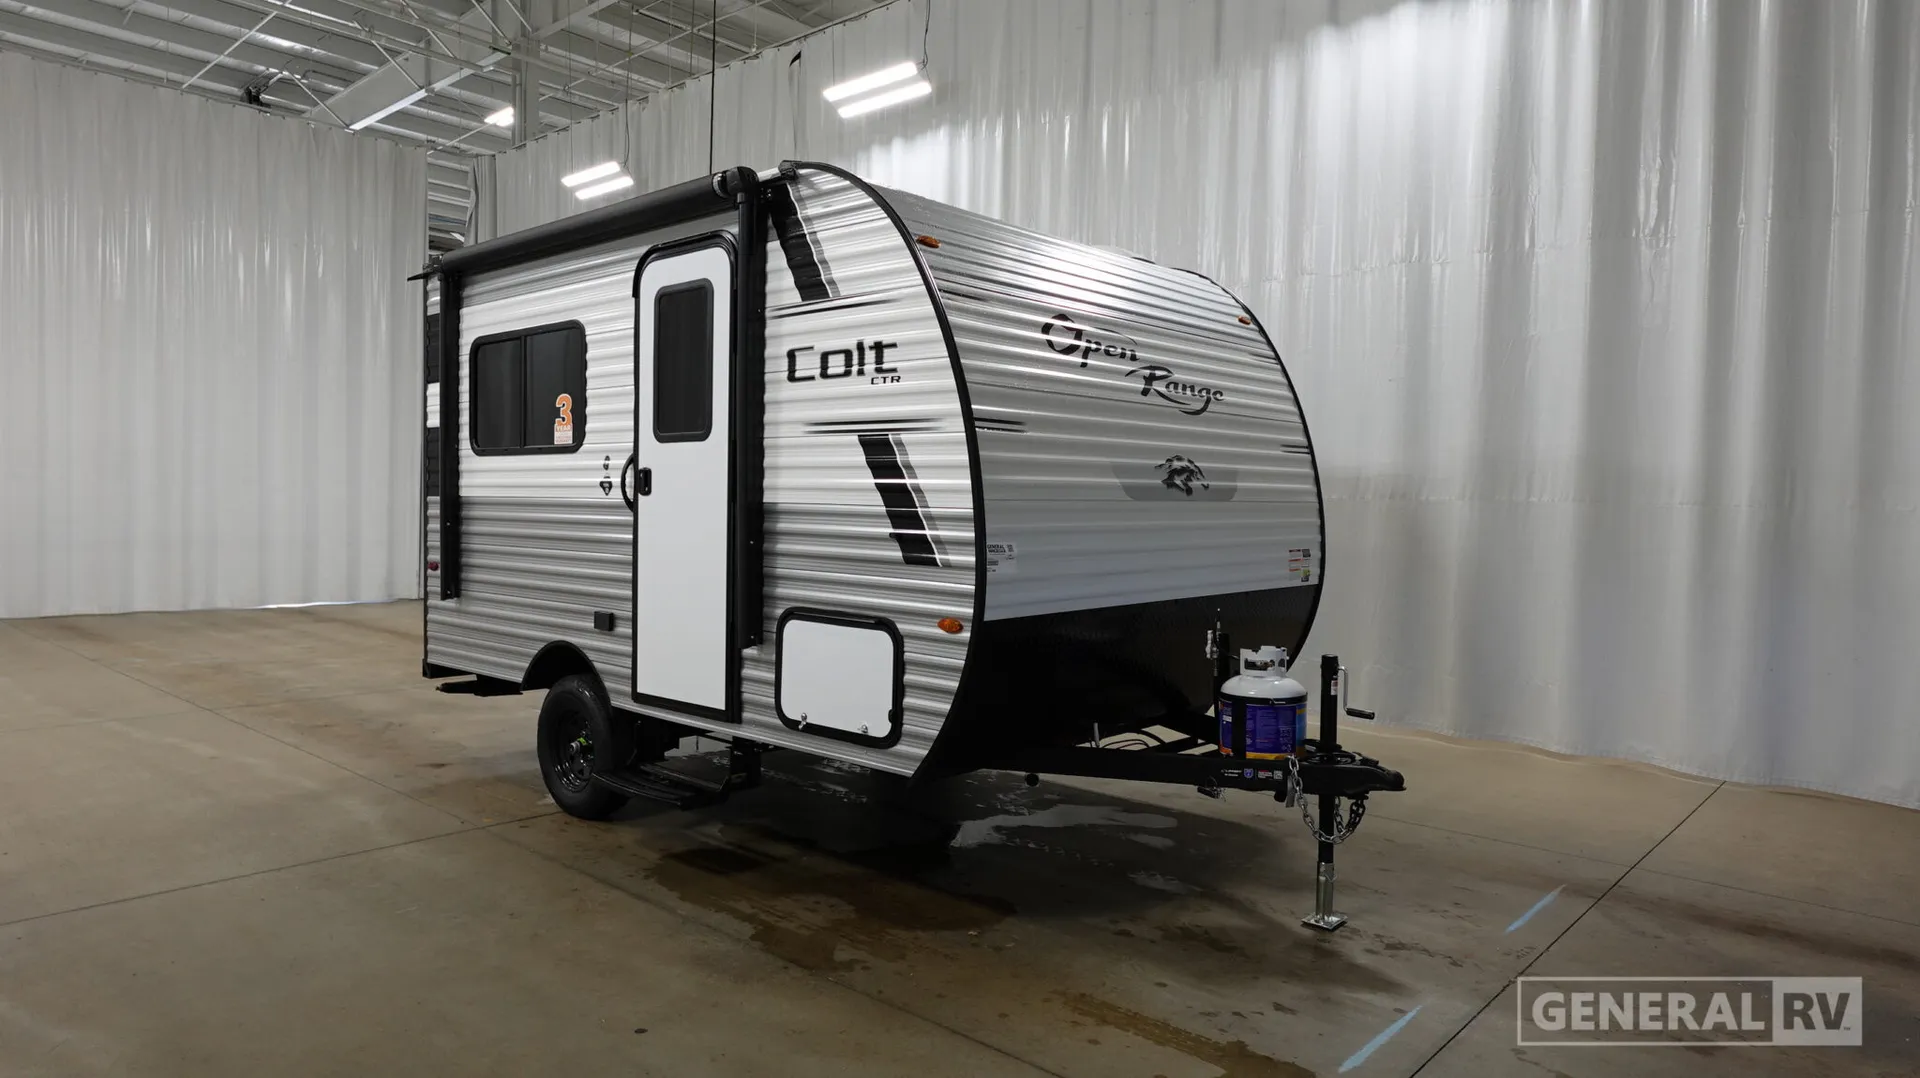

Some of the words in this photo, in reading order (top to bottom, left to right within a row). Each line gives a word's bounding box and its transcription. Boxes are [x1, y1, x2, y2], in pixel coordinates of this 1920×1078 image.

[786, 339, 898, 383] Colt
[1041, 313, 1140, 368] Open
[870, 375, 901, 385] CTR
[1125, 365, 1225, 415] Range
[555, 393, 572, 426] 3
